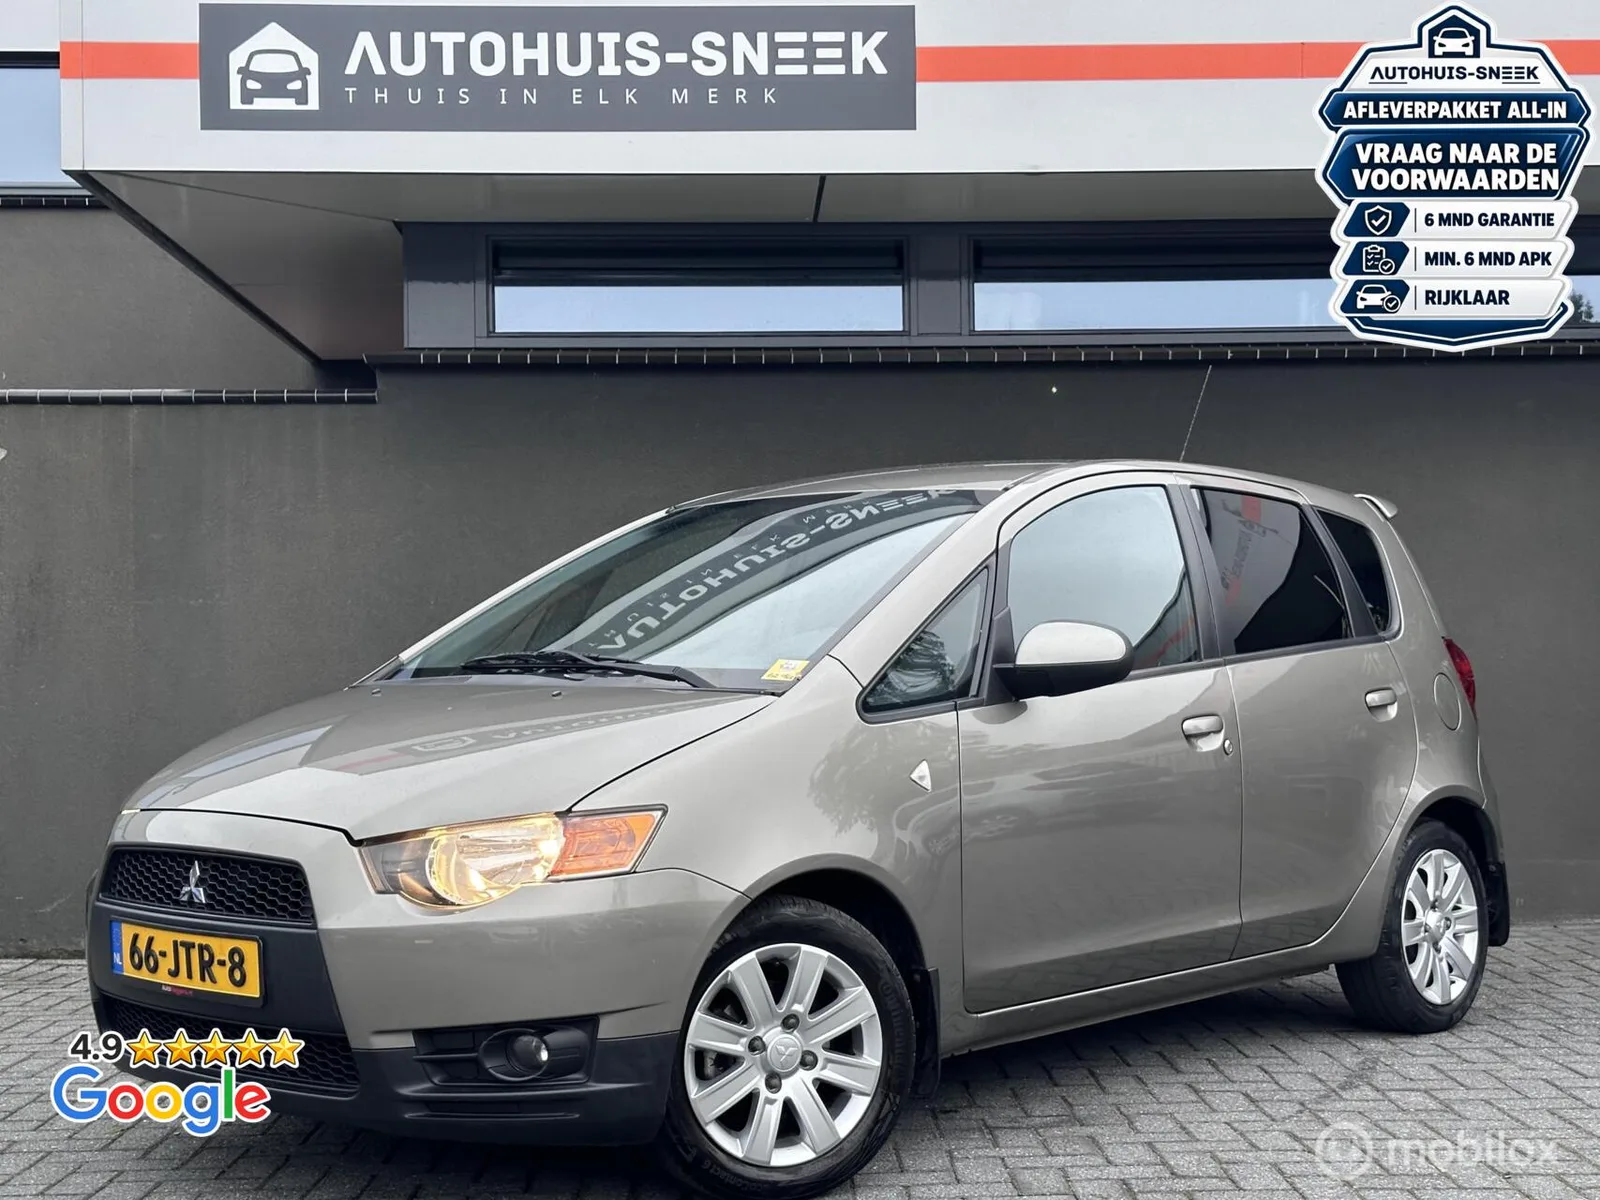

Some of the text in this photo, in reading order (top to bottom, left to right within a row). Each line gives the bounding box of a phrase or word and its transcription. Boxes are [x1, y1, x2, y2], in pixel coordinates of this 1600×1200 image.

[345, 31, 888, 76] AUTOHUIS-SNEEK
[345, 88, 777, 105] THUIS IN ELK MERK
[114, 952, 122, 965] NL
[129, 932, 247, 987] 66-JTR-8
